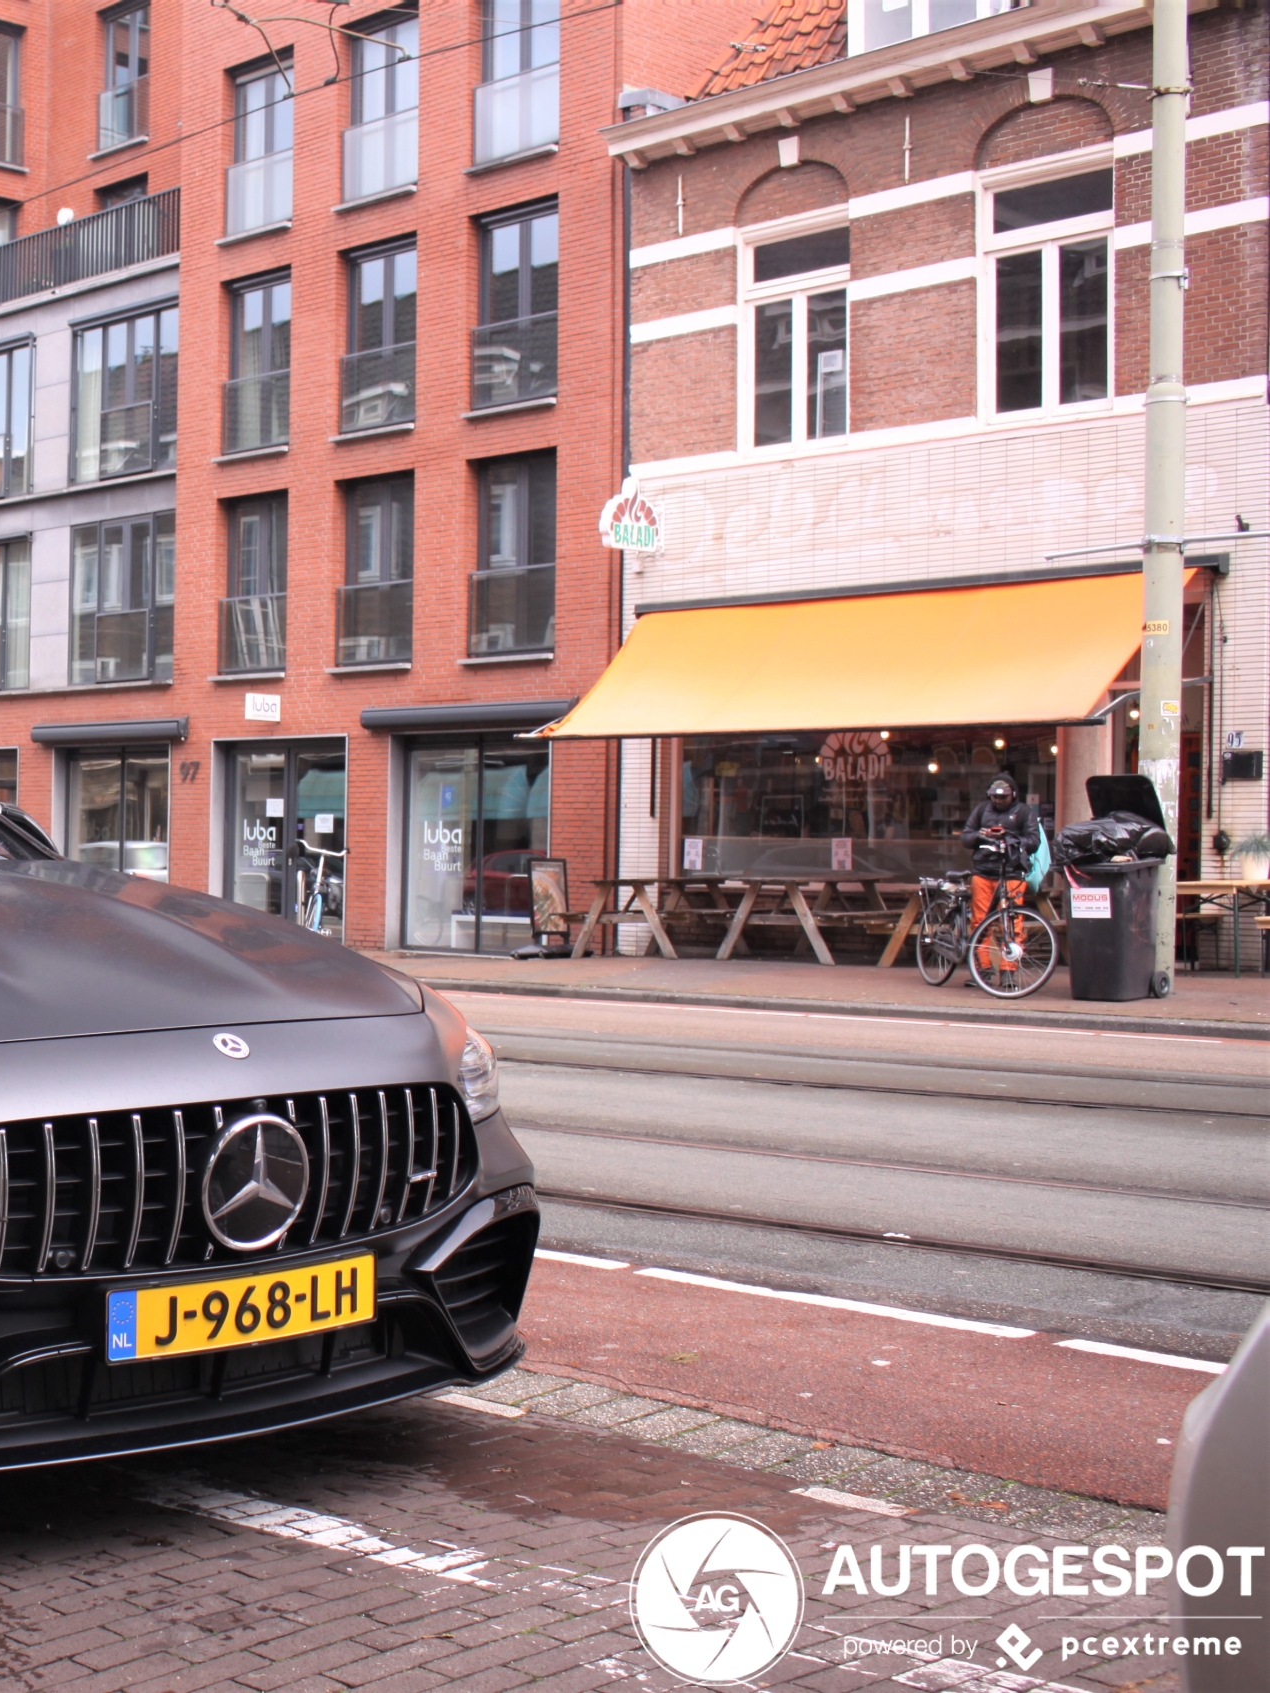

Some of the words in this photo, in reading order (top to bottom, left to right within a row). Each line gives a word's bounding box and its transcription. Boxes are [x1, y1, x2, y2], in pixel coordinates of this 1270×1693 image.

[614, 523, 655, 548] BALADI
[252, 696, 277, 713] luba
[179, 761, 200, 784] 97
[823, 754, 885, 782] BALADI
[243, 819, 276, 841] luba
[424, 820, 462, 845] luba
[243, 845, 265, 856] Baan
[258, 841, 276, 849] Beste
[441, 844, 462, 853] Beste
[252, 856, 275, 866] Buurt
[423, 849, 449, 861] Baan
[434, 861, 462, 872] Buurt
[154, 1267, 358, 1347] J-968-LH
[112, 1332, 132, 1349] NL
